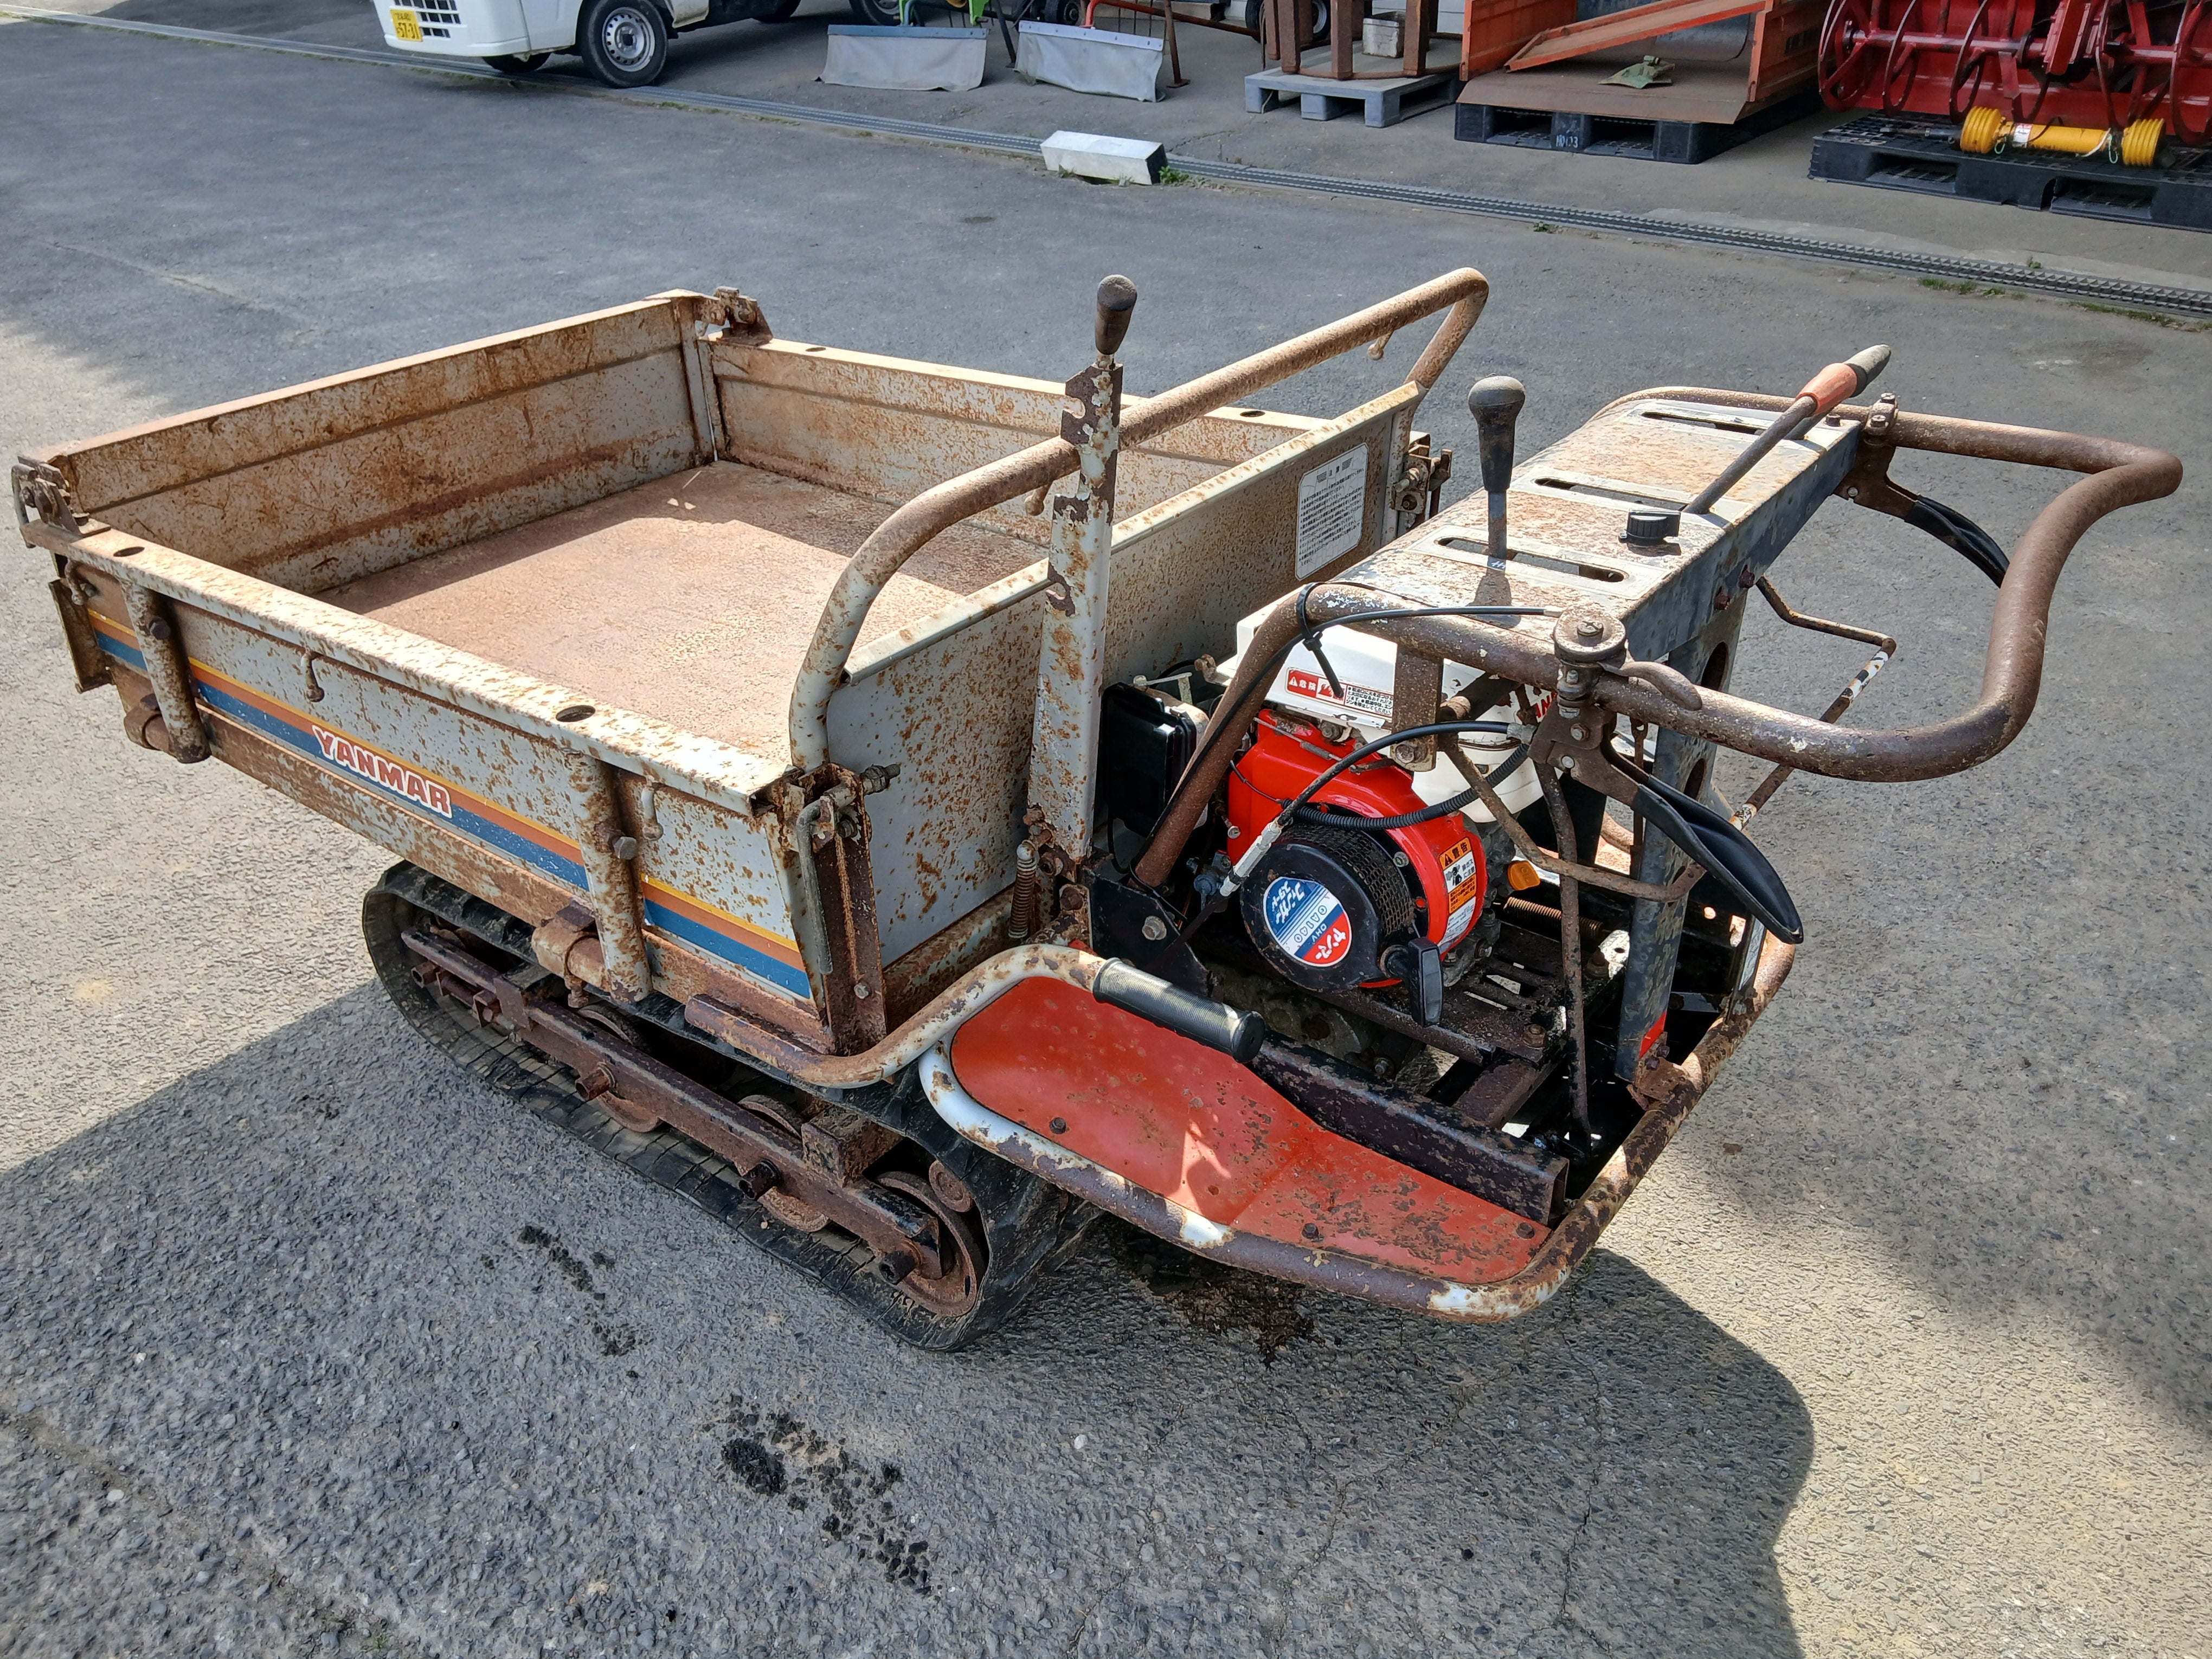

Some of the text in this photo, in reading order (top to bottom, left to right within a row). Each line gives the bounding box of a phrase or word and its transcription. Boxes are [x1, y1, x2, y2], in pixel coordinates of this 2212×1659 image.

[1298, 679, 1317, 691] 危険
[312, 725, 452, 818] YANMAR
[1452, 841, 1468, 859] 警告
[1272, 880, 1291, 912] スタート
[1275, 882, 1305, 924] フィンガー
[1294, 905, 1328, 943] GA140
[1311, 923, 1327, 943] OHV
[1315, 928, 1346, 960] ヤンマー
